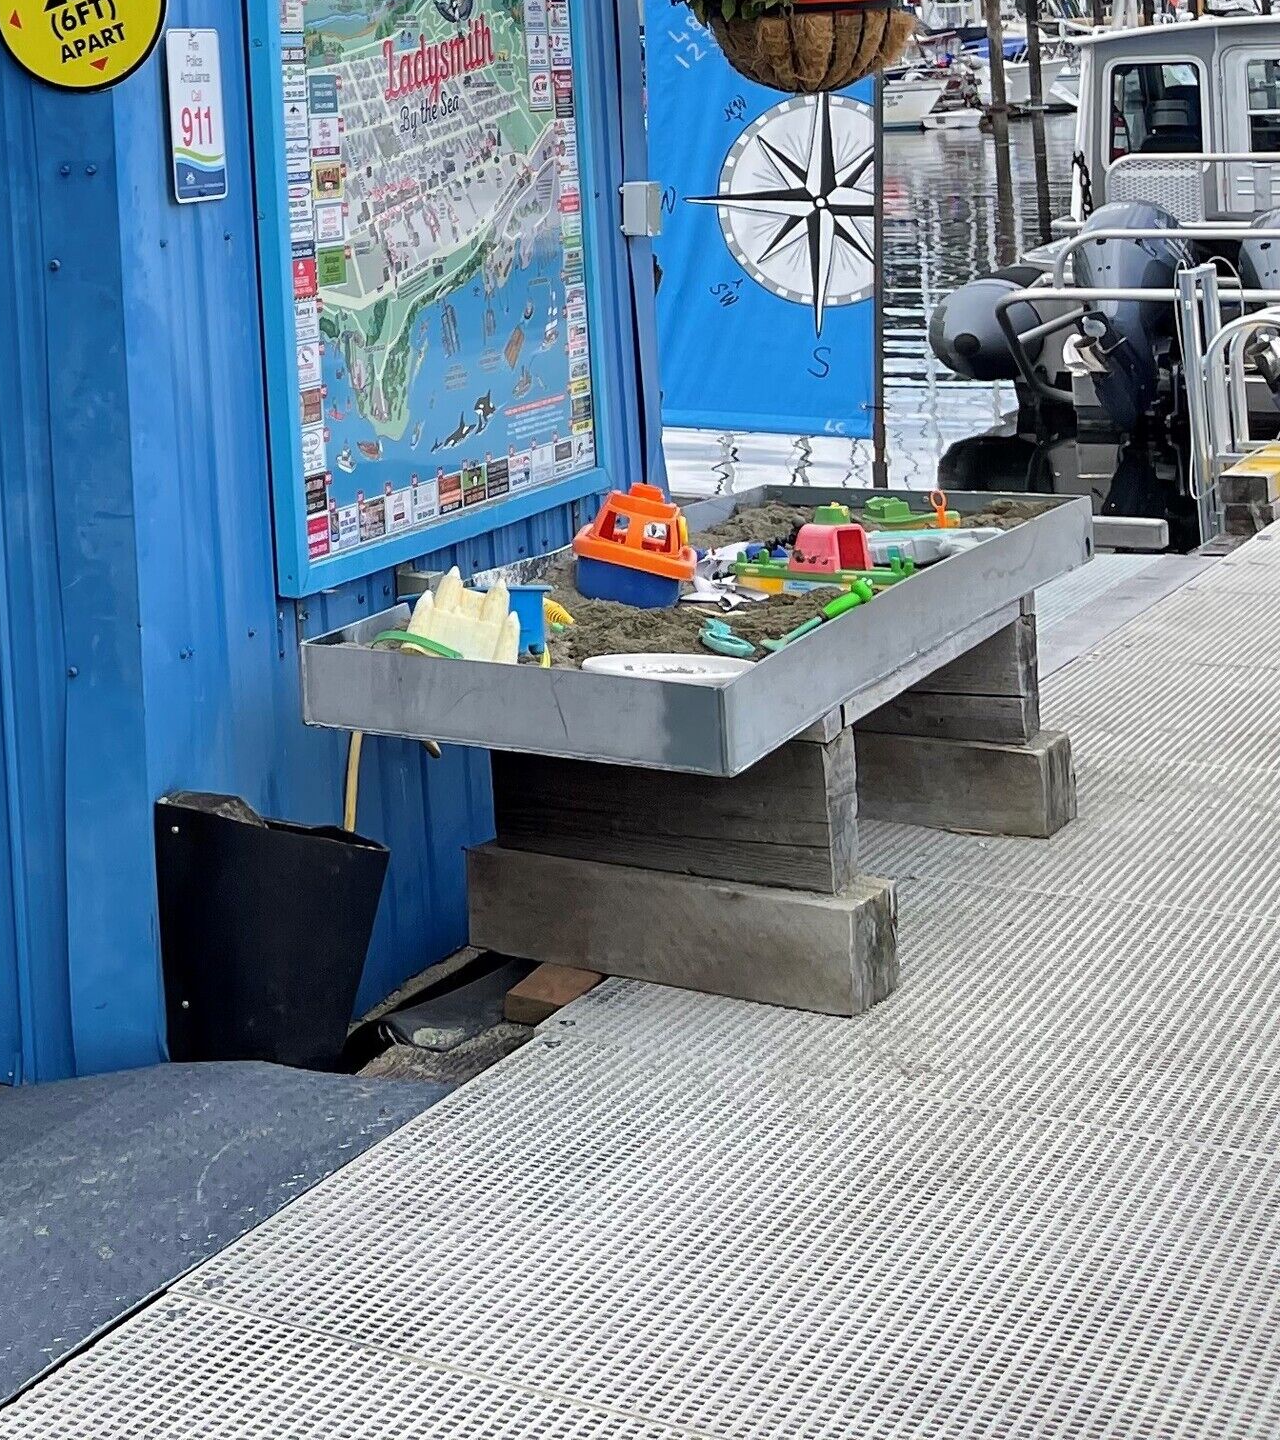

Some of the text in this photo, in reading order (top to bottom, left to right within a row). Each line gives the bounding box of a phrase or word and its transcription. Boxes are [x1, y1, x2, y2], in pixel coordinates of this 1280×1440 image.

[60, 23, 126, 63] APART
[383, 13, 495, 105] Ladysmith
[181, 106, 213, 147] 911
[400, 91, 459, 139] By the Sea
[709, 283, 739, 308] SW
[807, 346, 831, 378] S
